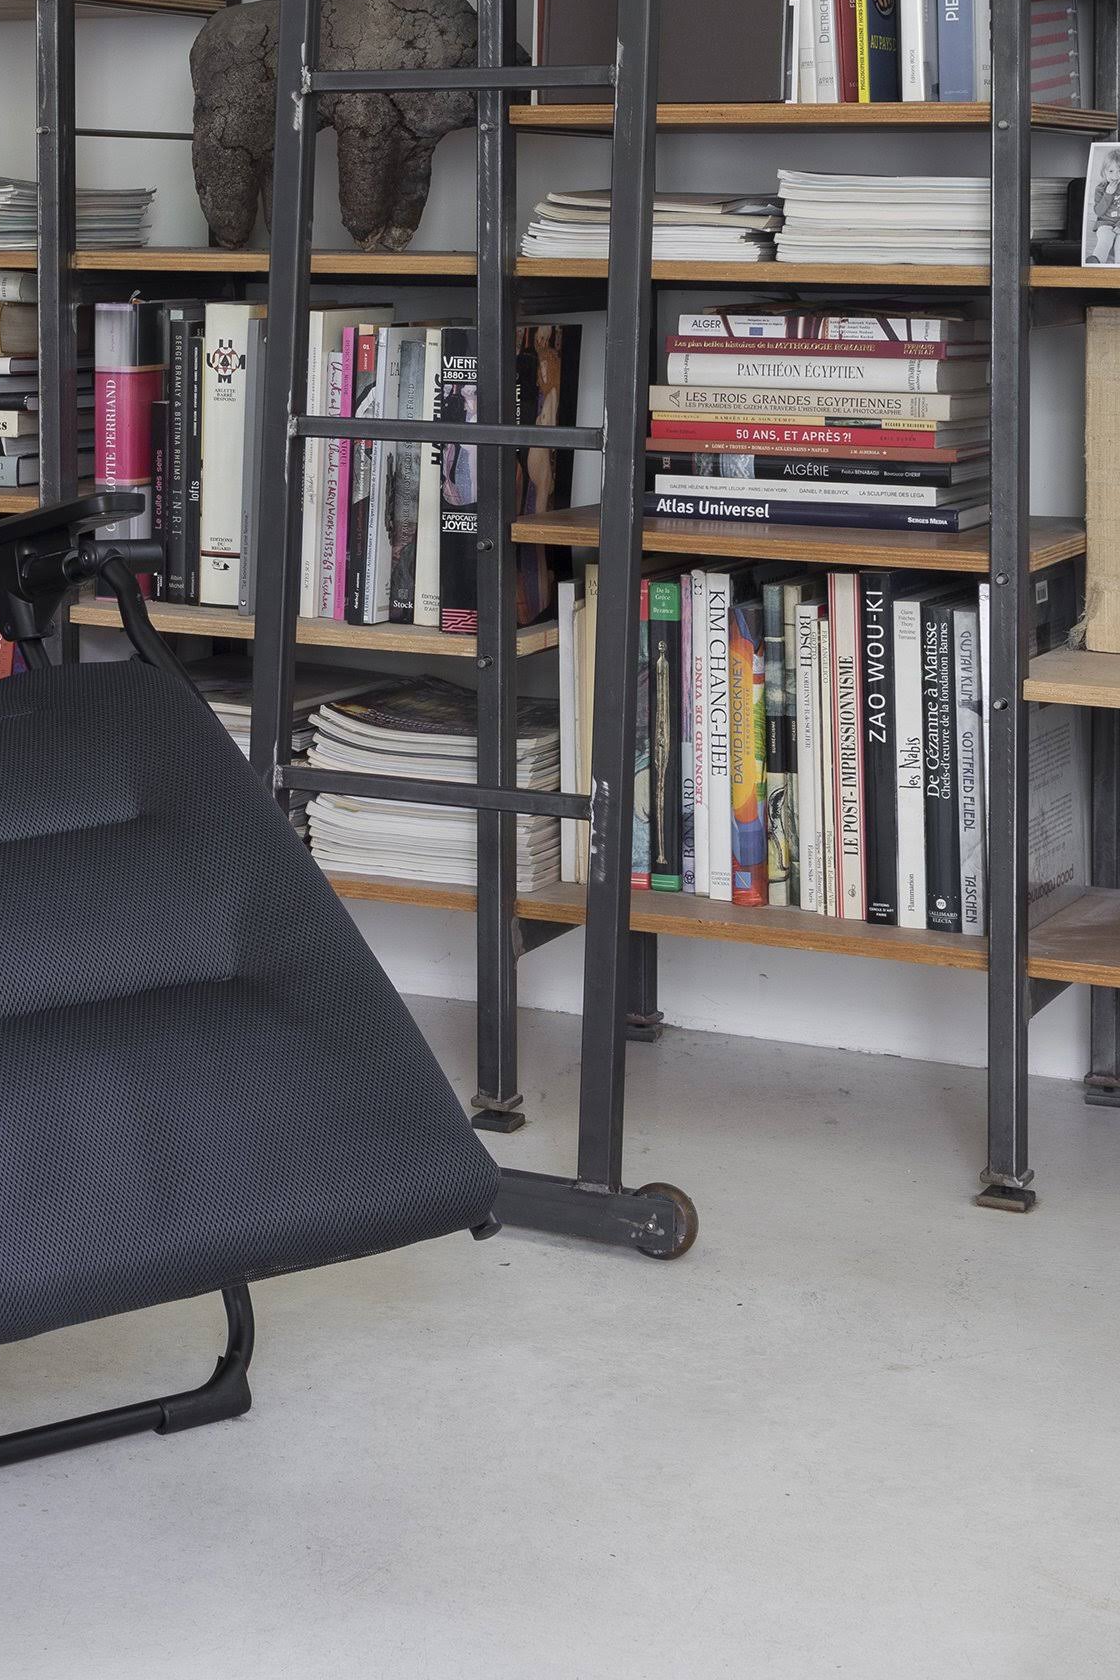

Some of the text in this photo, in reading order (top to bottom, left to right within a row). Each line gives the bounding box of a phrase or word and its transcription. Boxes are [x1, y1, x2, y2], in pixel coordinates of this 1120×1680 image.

[691, 319, 721, 329] ALGER
[737, 361, 865, 380] PANTHÉON ÉGYPTIEN
[685, 392, 902, 409] LES TROIS GRANDES EGYPTIENNES
[105, 379, 117, 532] CLOTTE PERRIAND
[736, 429, 749, 440] 50
[753, 429, 780, 442] ANS,
[784, 431, 798, 441] ET
[189, 481, 199, 502] lofts
[783, 462, 830, 478] ALGÉRIE
[656, 498, 770, 519] Atlas Universel
[392, 599, 413, 609] Stock
[798, 615, 813, 668] BOSCH
[960, 630, 973, 673] GUSTAV
[709, 589, 729, 776] KIM CHANG-HEE
[865, 591, 887, 743] ZAO WOU-KI
[694, 656, 704, 807] LEONARD DE VINCI
[731, 655, 744, 785] DAVID HOCKNEY
[838, 655, 856, 788] IMPRESSIONNISME
[924, 622, 940, 798] De Cézanne à Matisse
[939, 622, 951, 799] Chefs-d'œuvre de la fondation Barnes
[898, 737, 921, 789] les Nabis
[962, 731, 976, 831] GOTTFRIED FLIEDL
[683, 777, 695, 859] BONNARD
[844, 837, 859, 856] LE
[907, 874, 915, 913] Flammarion
[965, 875, 977, 924] TASCHEN
